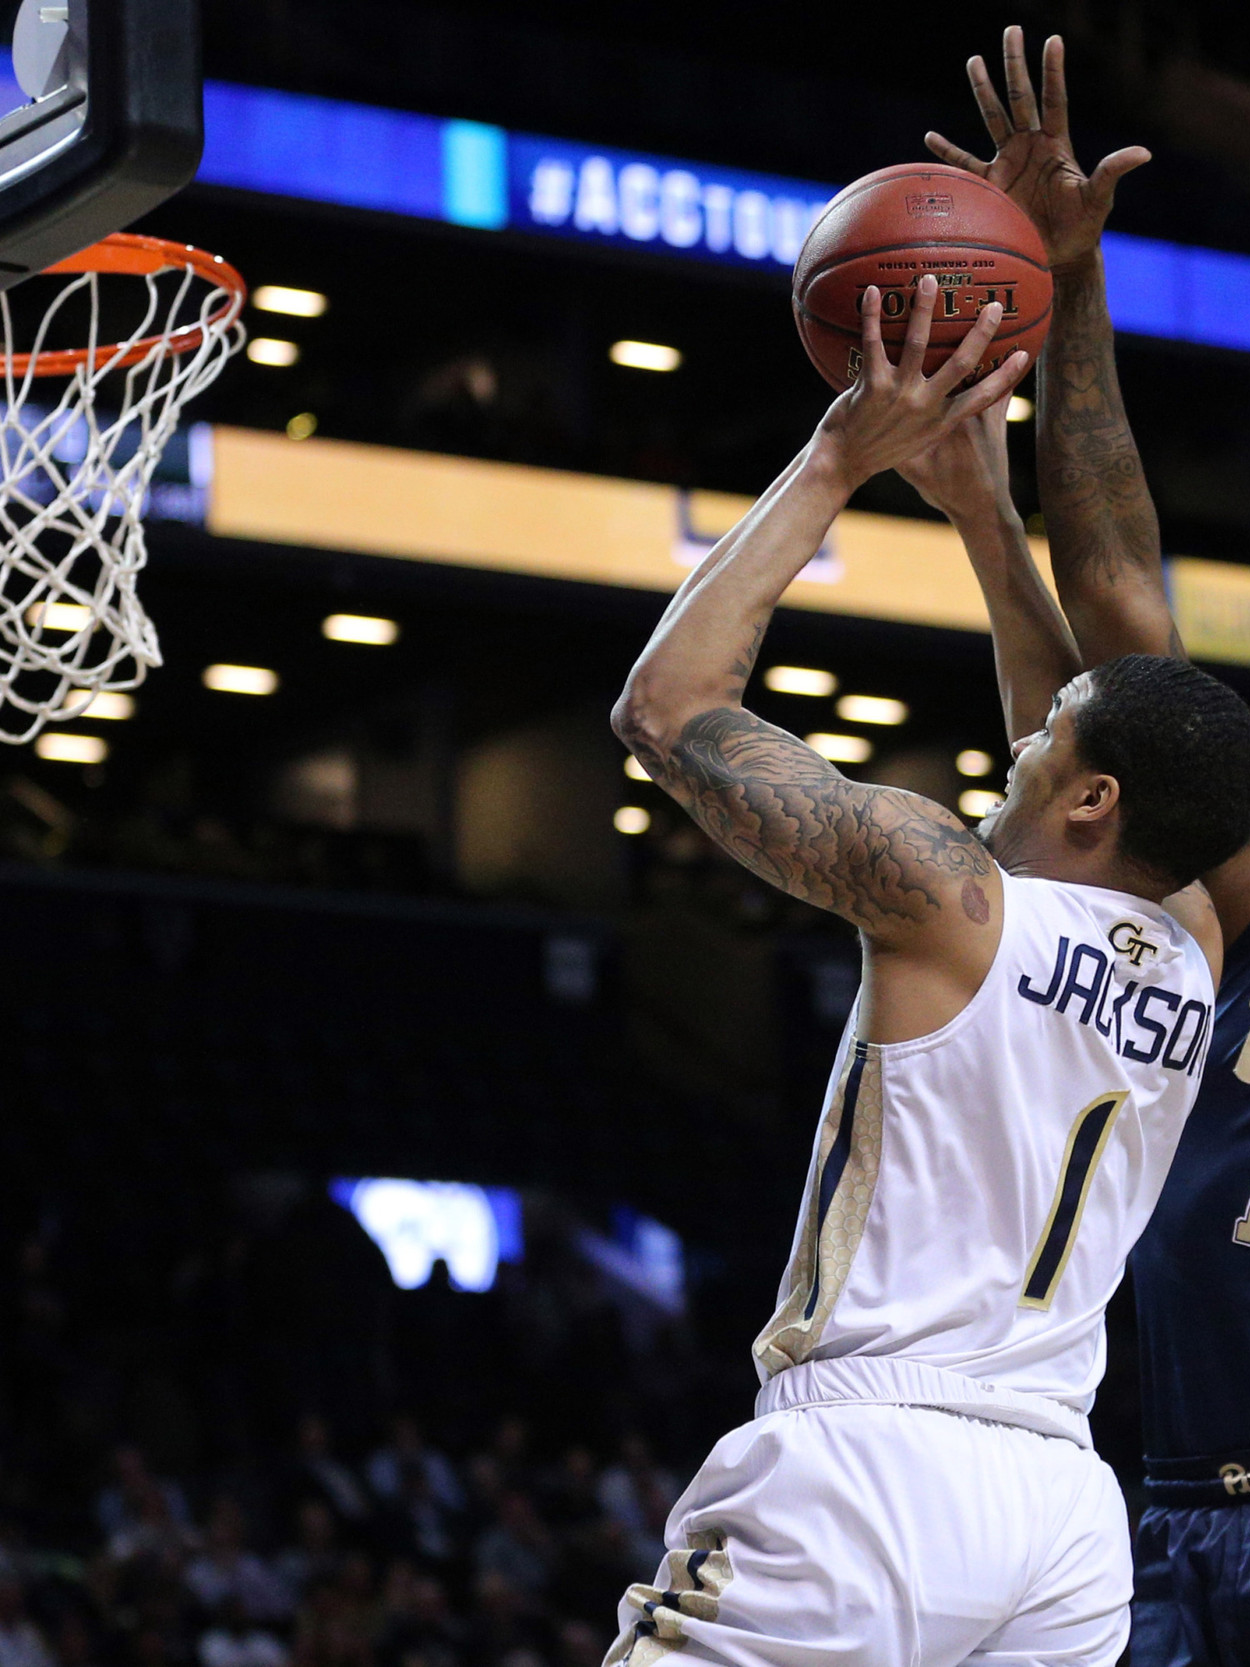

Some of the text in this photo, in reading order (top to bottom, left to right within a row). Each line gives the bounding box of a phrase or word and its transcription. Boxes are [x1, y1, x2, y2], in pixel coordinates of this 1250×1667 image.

[878, 259, 996, 270] DEEP CHANNEL DESIGN
[1107, 922, 1158, 966] GT
[1017, 1088, 1132, 1312] 1
